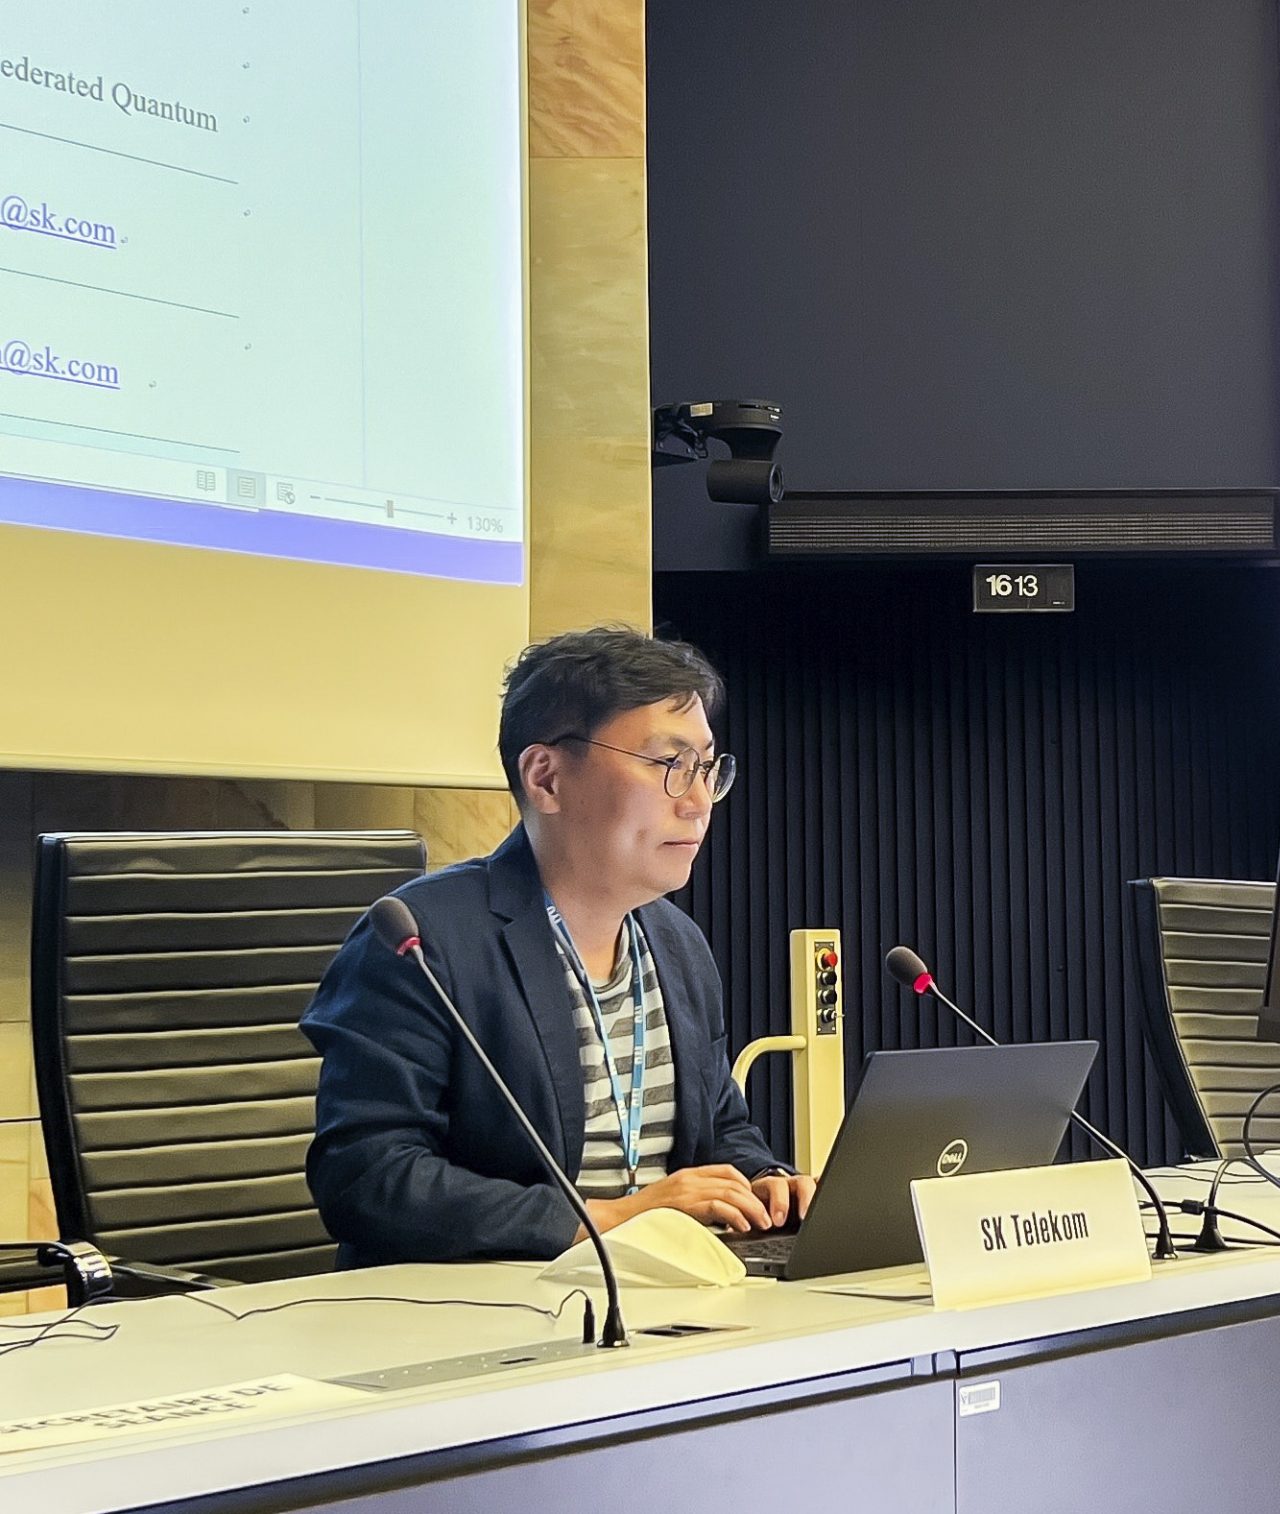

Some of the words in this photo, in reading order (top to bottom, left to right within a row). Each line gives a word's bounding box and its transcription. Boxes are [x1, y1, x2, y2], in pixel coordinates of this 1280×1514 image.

[112, 82, 218, 132] Quantum
[0, 340, 120, 390] @sk.com
[467, 515, 504, 534] 130%
[981, 1216, 1007, 1251] SK
[1010, 1210, 1089, 1247] Telekom
[229, 1382, 292, 1398] DE
